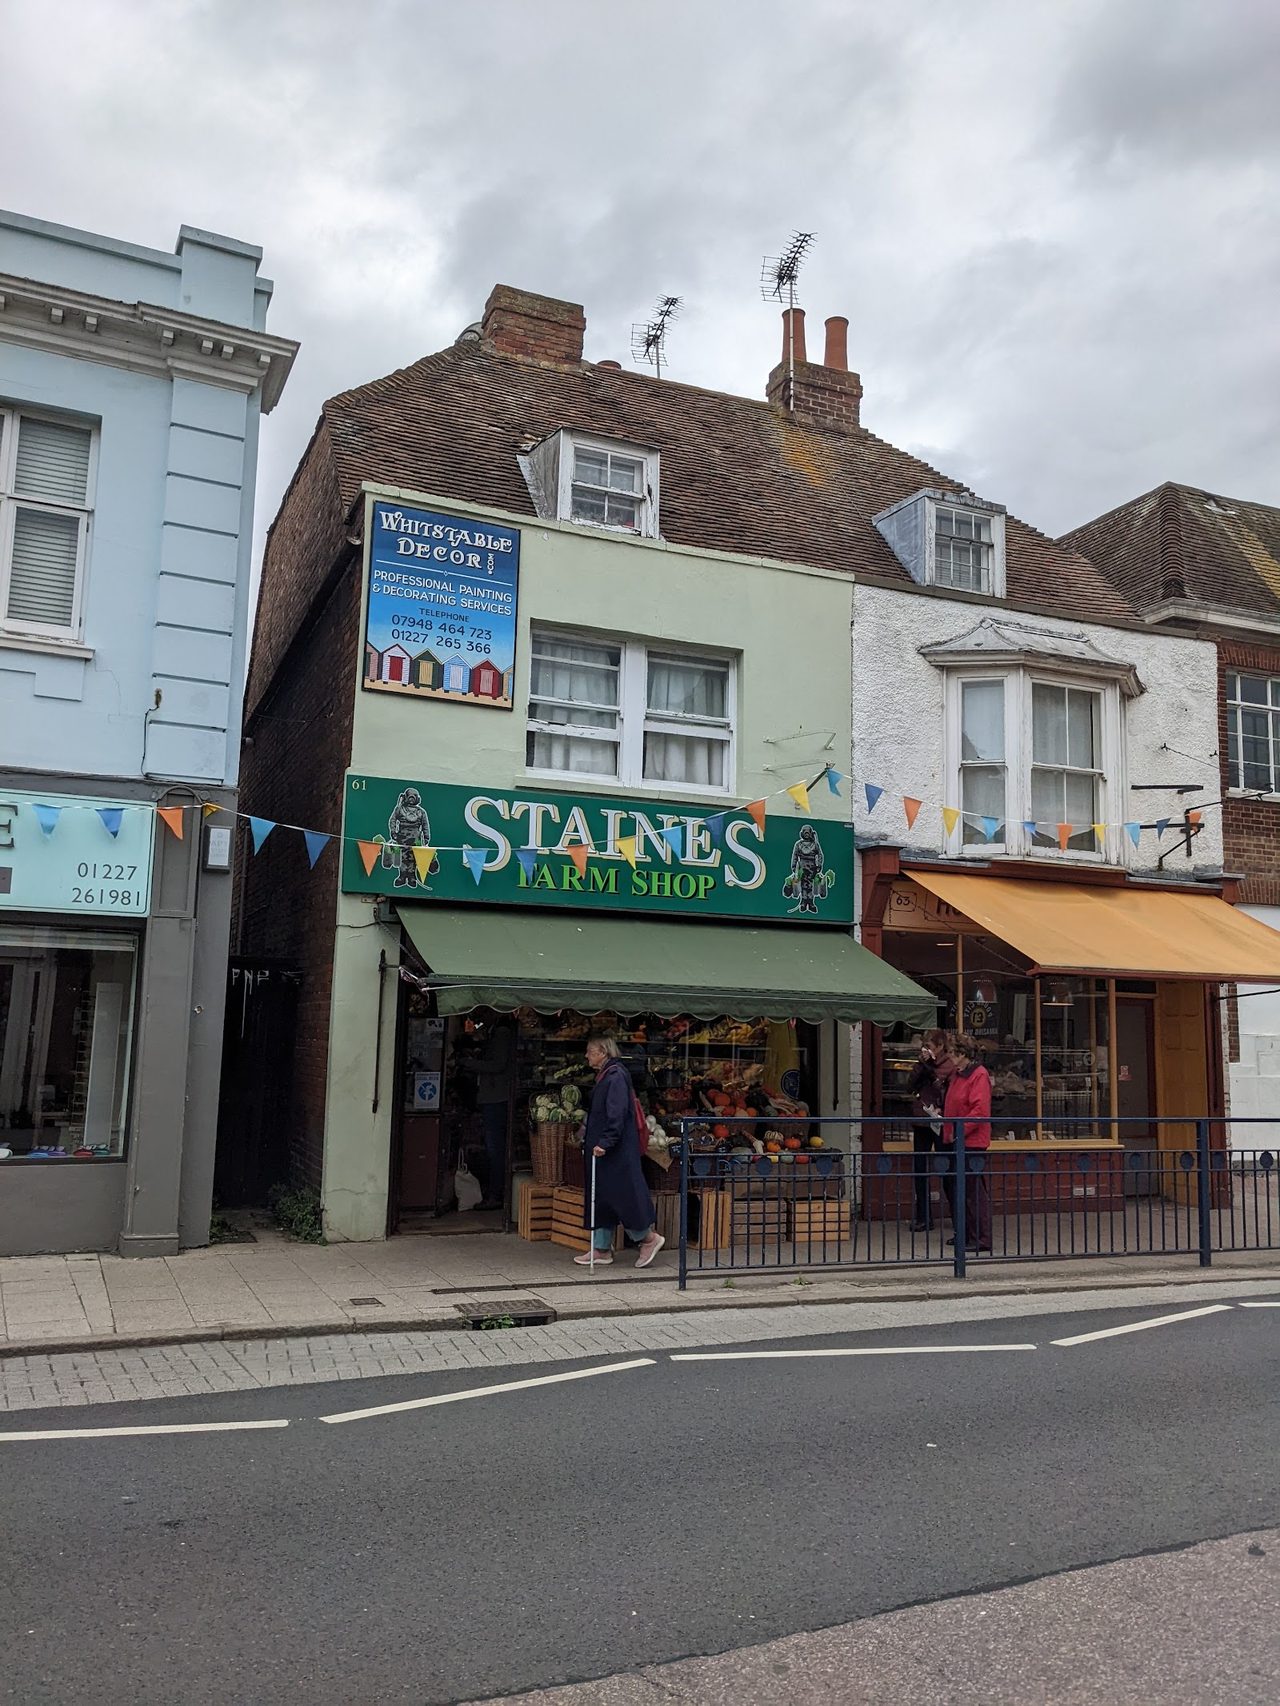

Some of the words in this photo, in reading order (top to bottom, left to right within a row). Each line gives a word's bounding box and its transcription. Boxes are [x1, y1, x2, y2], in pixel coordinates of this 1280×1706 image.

[379, 511, 513, 553] WHITSTABLE
[397, 537, 482, 568] DECOR
[372, 583, 381, 593] &
[383, 584, 457, 606] DECORATING
[460, 598, 512, 616] SERVICES
[374, 569, 455, 593] PROFESSIONAL
[459, 584, 512, 603] PAINTING
[392, 614, 433, 631] 07948
[438, 622, 465, 636] 464
[469, 627, 492, 641] 723
[419, 607, 470, 622] TELEPHONE
[391, 628, 429, 643] 01227
[436, 635, 461, 650] 265
[466, 640, 491, 655] 366
[351, 779, 367, 791] 61
[462, 796, 766, 890] STAINES
[77, 862, 138, 880] 01227
[631, 869, 717, 899] SHOP
[71, 887, 140, 906] 261981
[896, 895, 910, 906] 63
